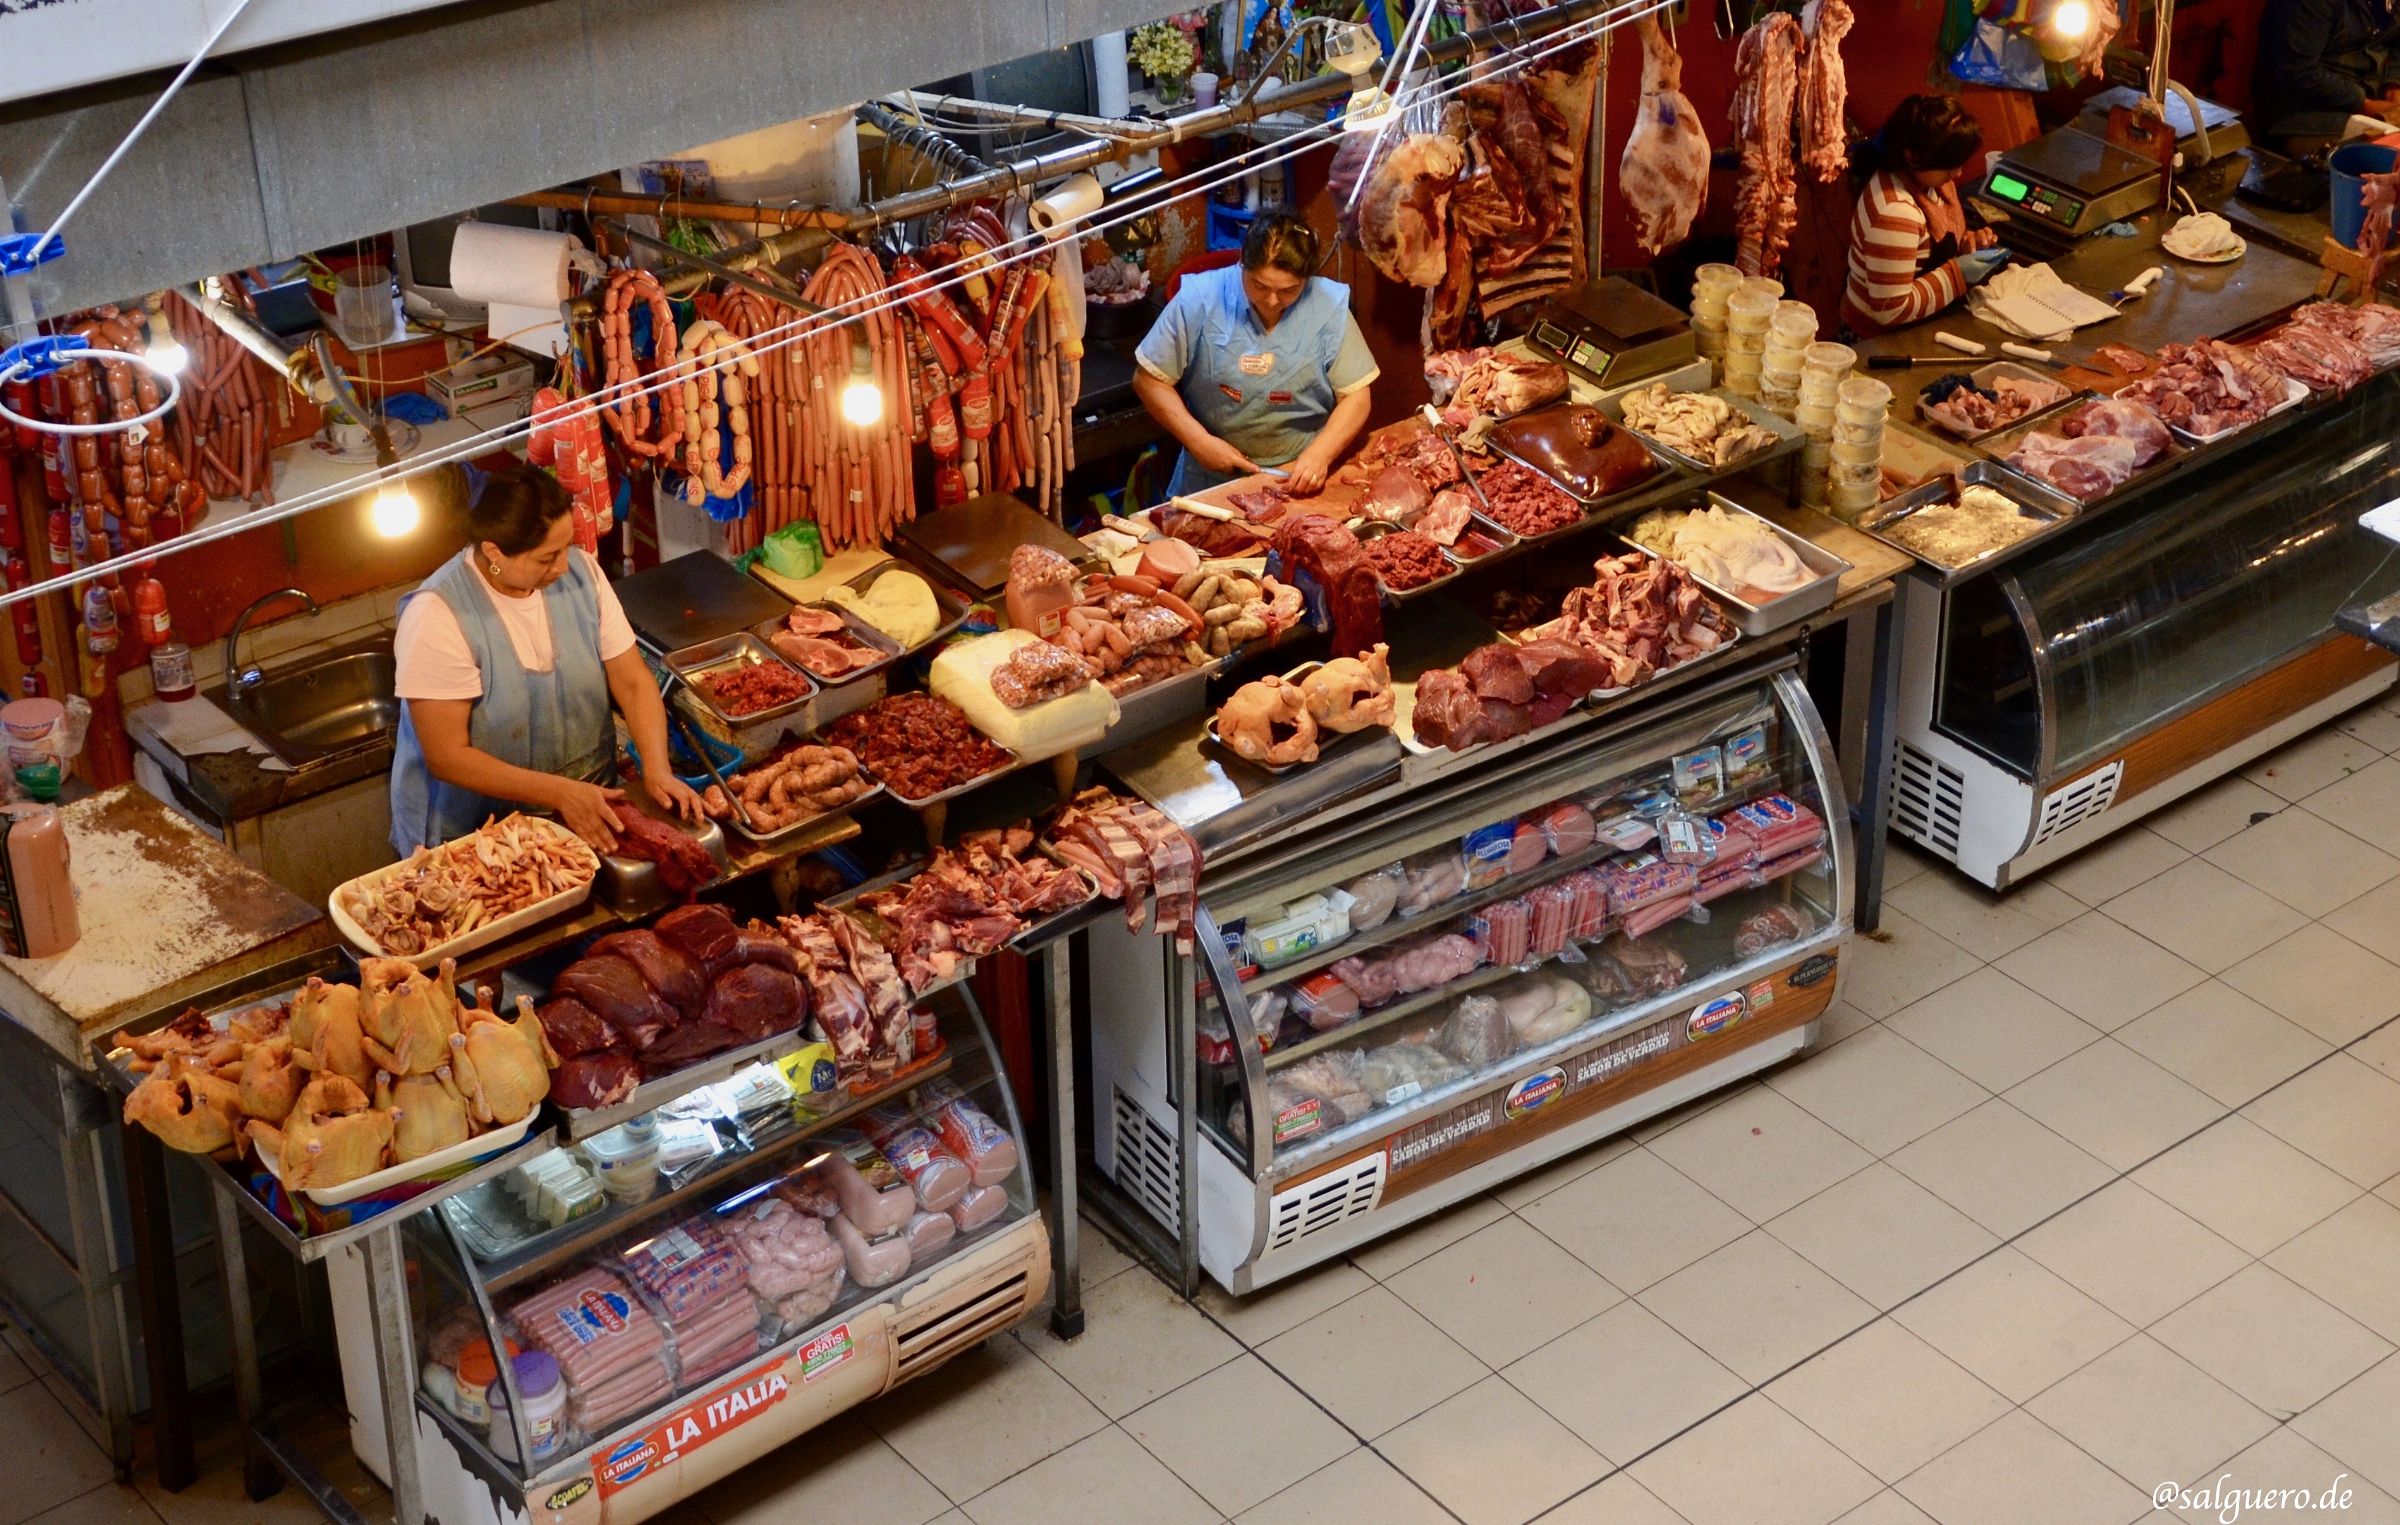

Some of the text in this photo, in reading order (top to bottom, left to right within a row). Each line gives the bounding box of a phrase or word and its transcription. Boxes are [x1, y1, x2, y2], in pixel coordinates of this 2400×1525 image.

[1696, 1006, 1737, 1029] LA ITALIANA
[1577, 1037, 1670, 1082] SABOR DE VERDAD
[1514, 1081, 1557, 1106] LA ITALIANA
[1392, 1114, 1491, 1165] SABOR DE VERDAD
[807, 1331, 845, 1359] GRATIS!
[666, 1374, 787, 1450] LA ITALIA
[603, 1447, 655, 1480] LA ITALIANA
